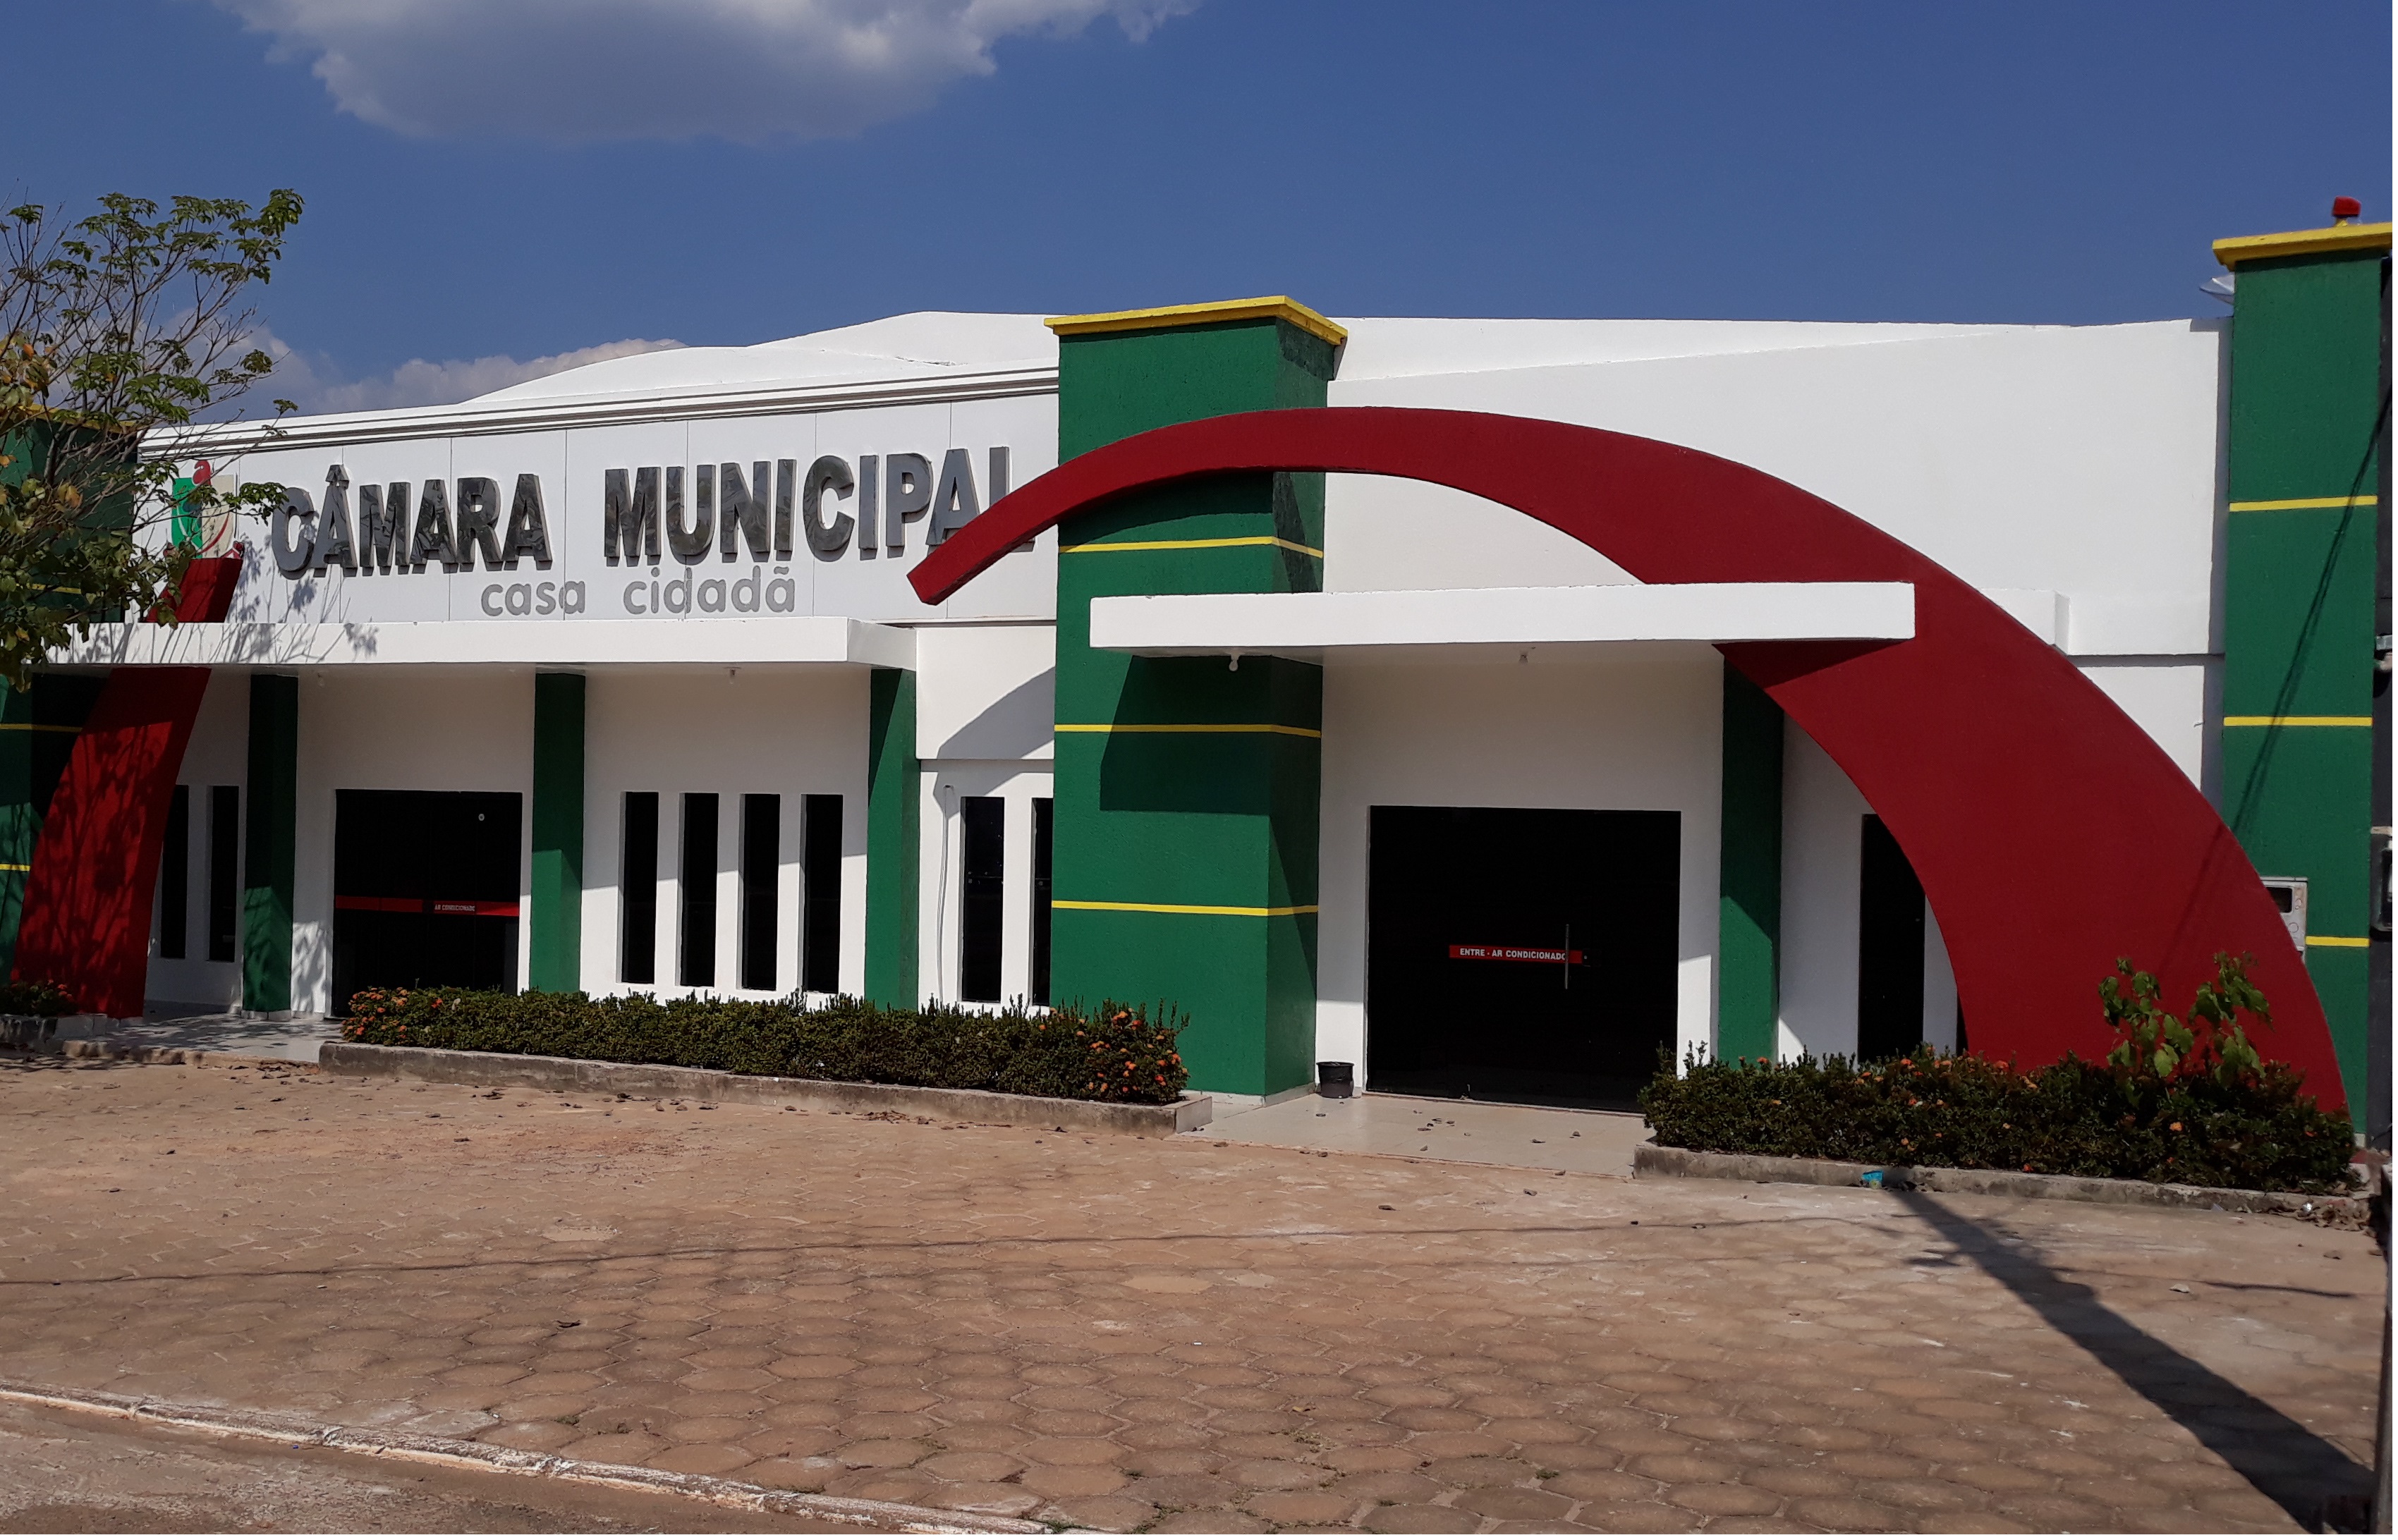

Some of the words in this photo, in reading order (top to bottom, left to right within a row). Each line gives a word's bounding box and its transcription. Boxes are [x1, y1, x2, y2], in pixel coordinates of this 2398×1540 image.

[271, 464, 554, 580] CÂMARA
[481, 580, 586, 616] casa
[623, 566, 796, 615] cidadã
[1460, 948, 1485, 957] ENTRE
